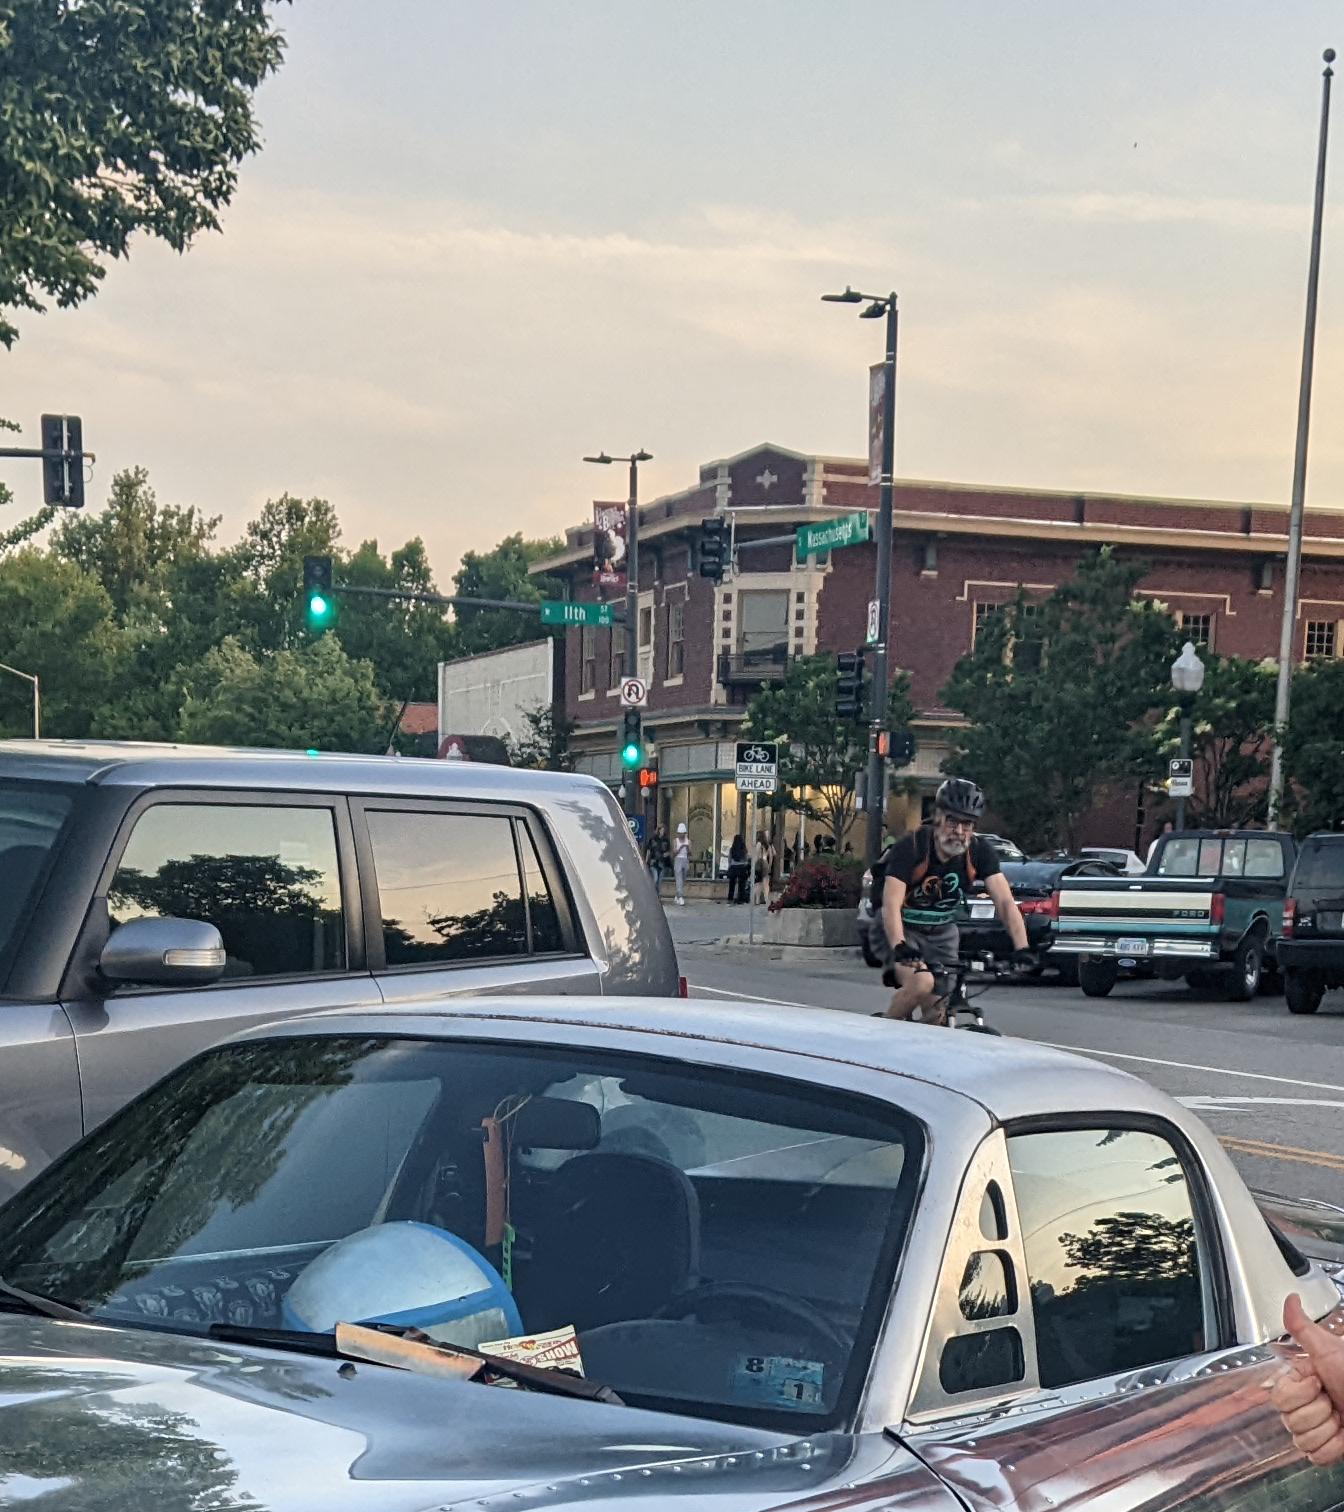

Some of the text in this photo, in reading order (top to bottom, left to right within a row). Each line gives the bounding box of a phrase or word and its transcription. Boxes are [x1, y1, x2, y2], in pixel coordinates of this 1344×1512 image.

[564, 605, 586, 621] 11th
[738, 764, 774, 774] BIKE LANE
[741, 779, 772, 789] AHEAD
[1173, 909, 1205, 918] FORD
[539, 1340, 579, 1362] SHOW
[746, 1357, 765, 1373] 8
